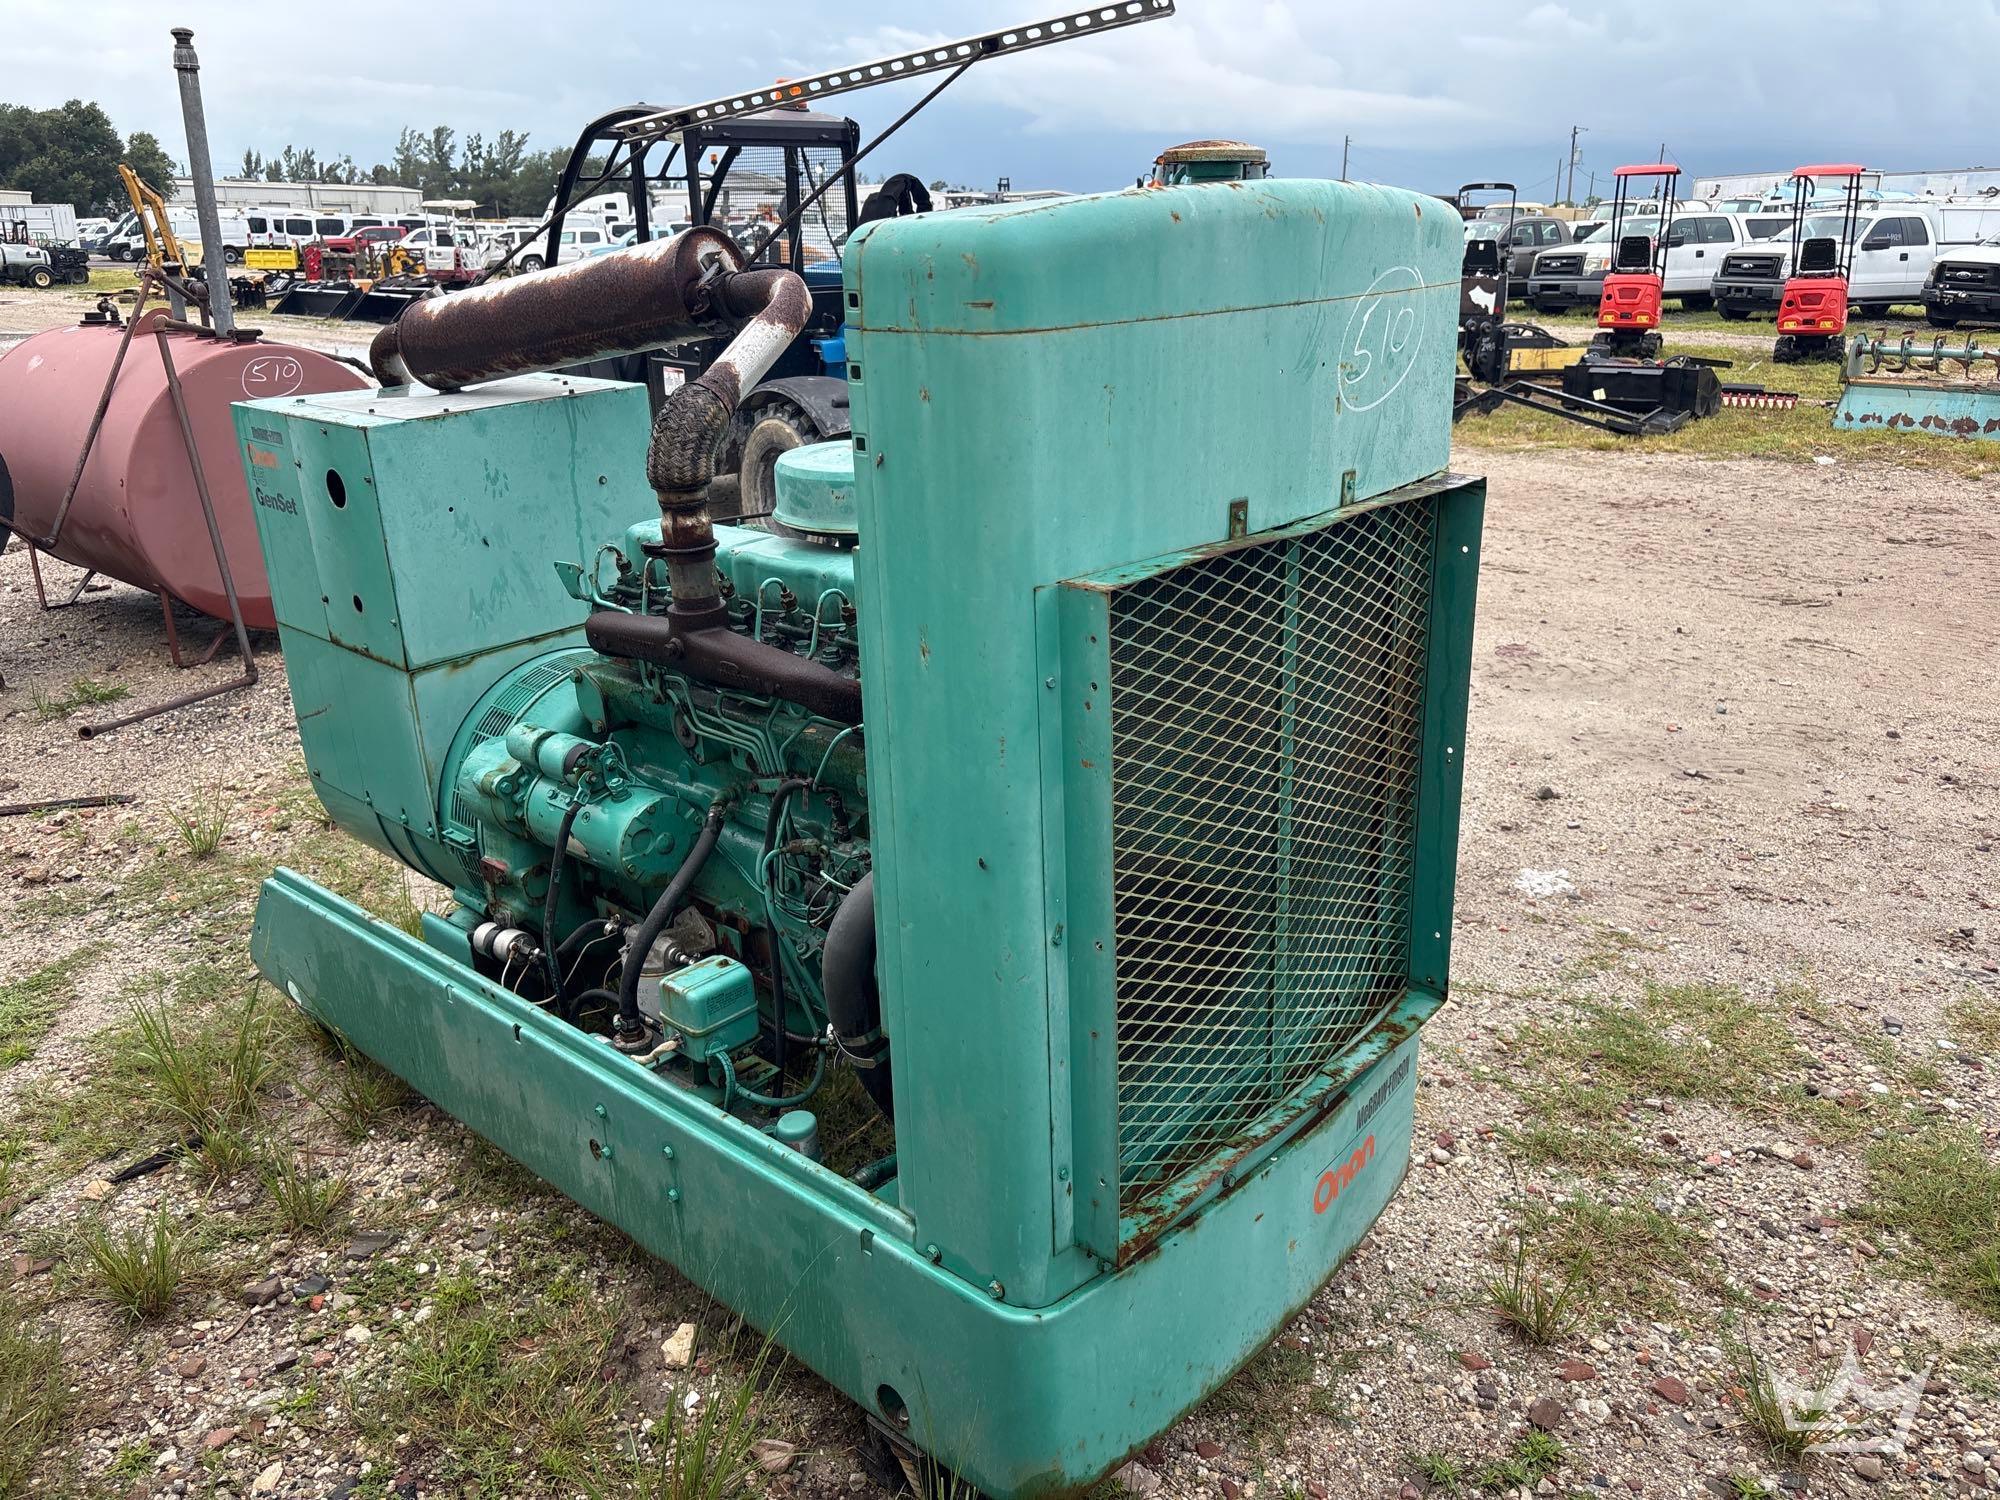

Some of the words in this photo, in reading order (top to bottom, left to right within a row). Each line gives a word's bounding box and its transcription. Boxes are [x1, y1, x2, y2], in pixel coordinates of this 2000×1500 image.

[1345, 297, 1414, 384] 510
[249, 361, 297, 382] 510
[255, 486, 298, 515] GenSet
[1313, 1134, 1376, 1215] Onan
